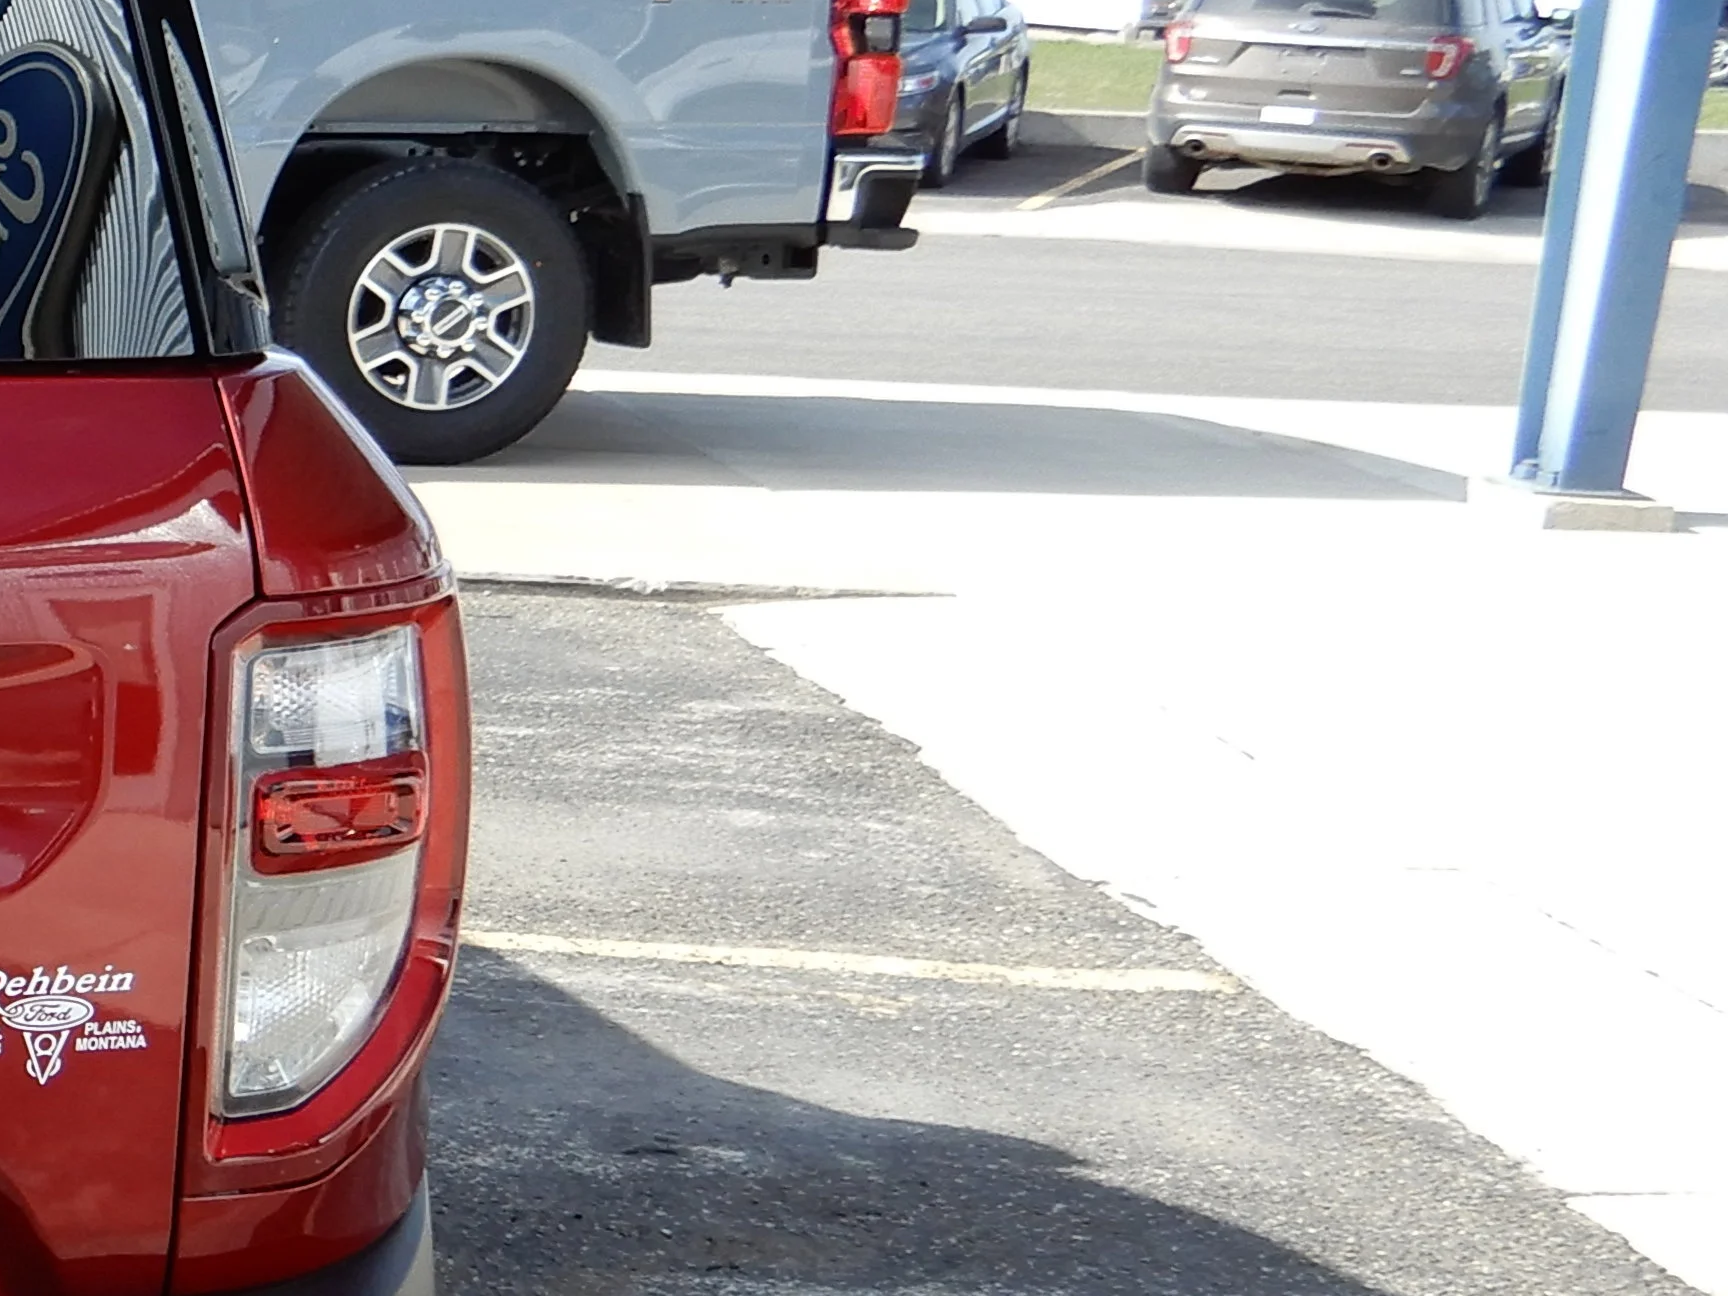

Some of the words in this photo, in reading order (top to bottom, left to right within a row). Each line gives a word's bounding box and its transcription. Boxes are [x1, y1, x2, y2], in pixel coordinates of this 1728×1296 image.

[24, 1004, 72, 1021] Ford
[84, 1020, 141, 1035] PLAINS,
[75, 1035, 147, 1052] MONTANA
